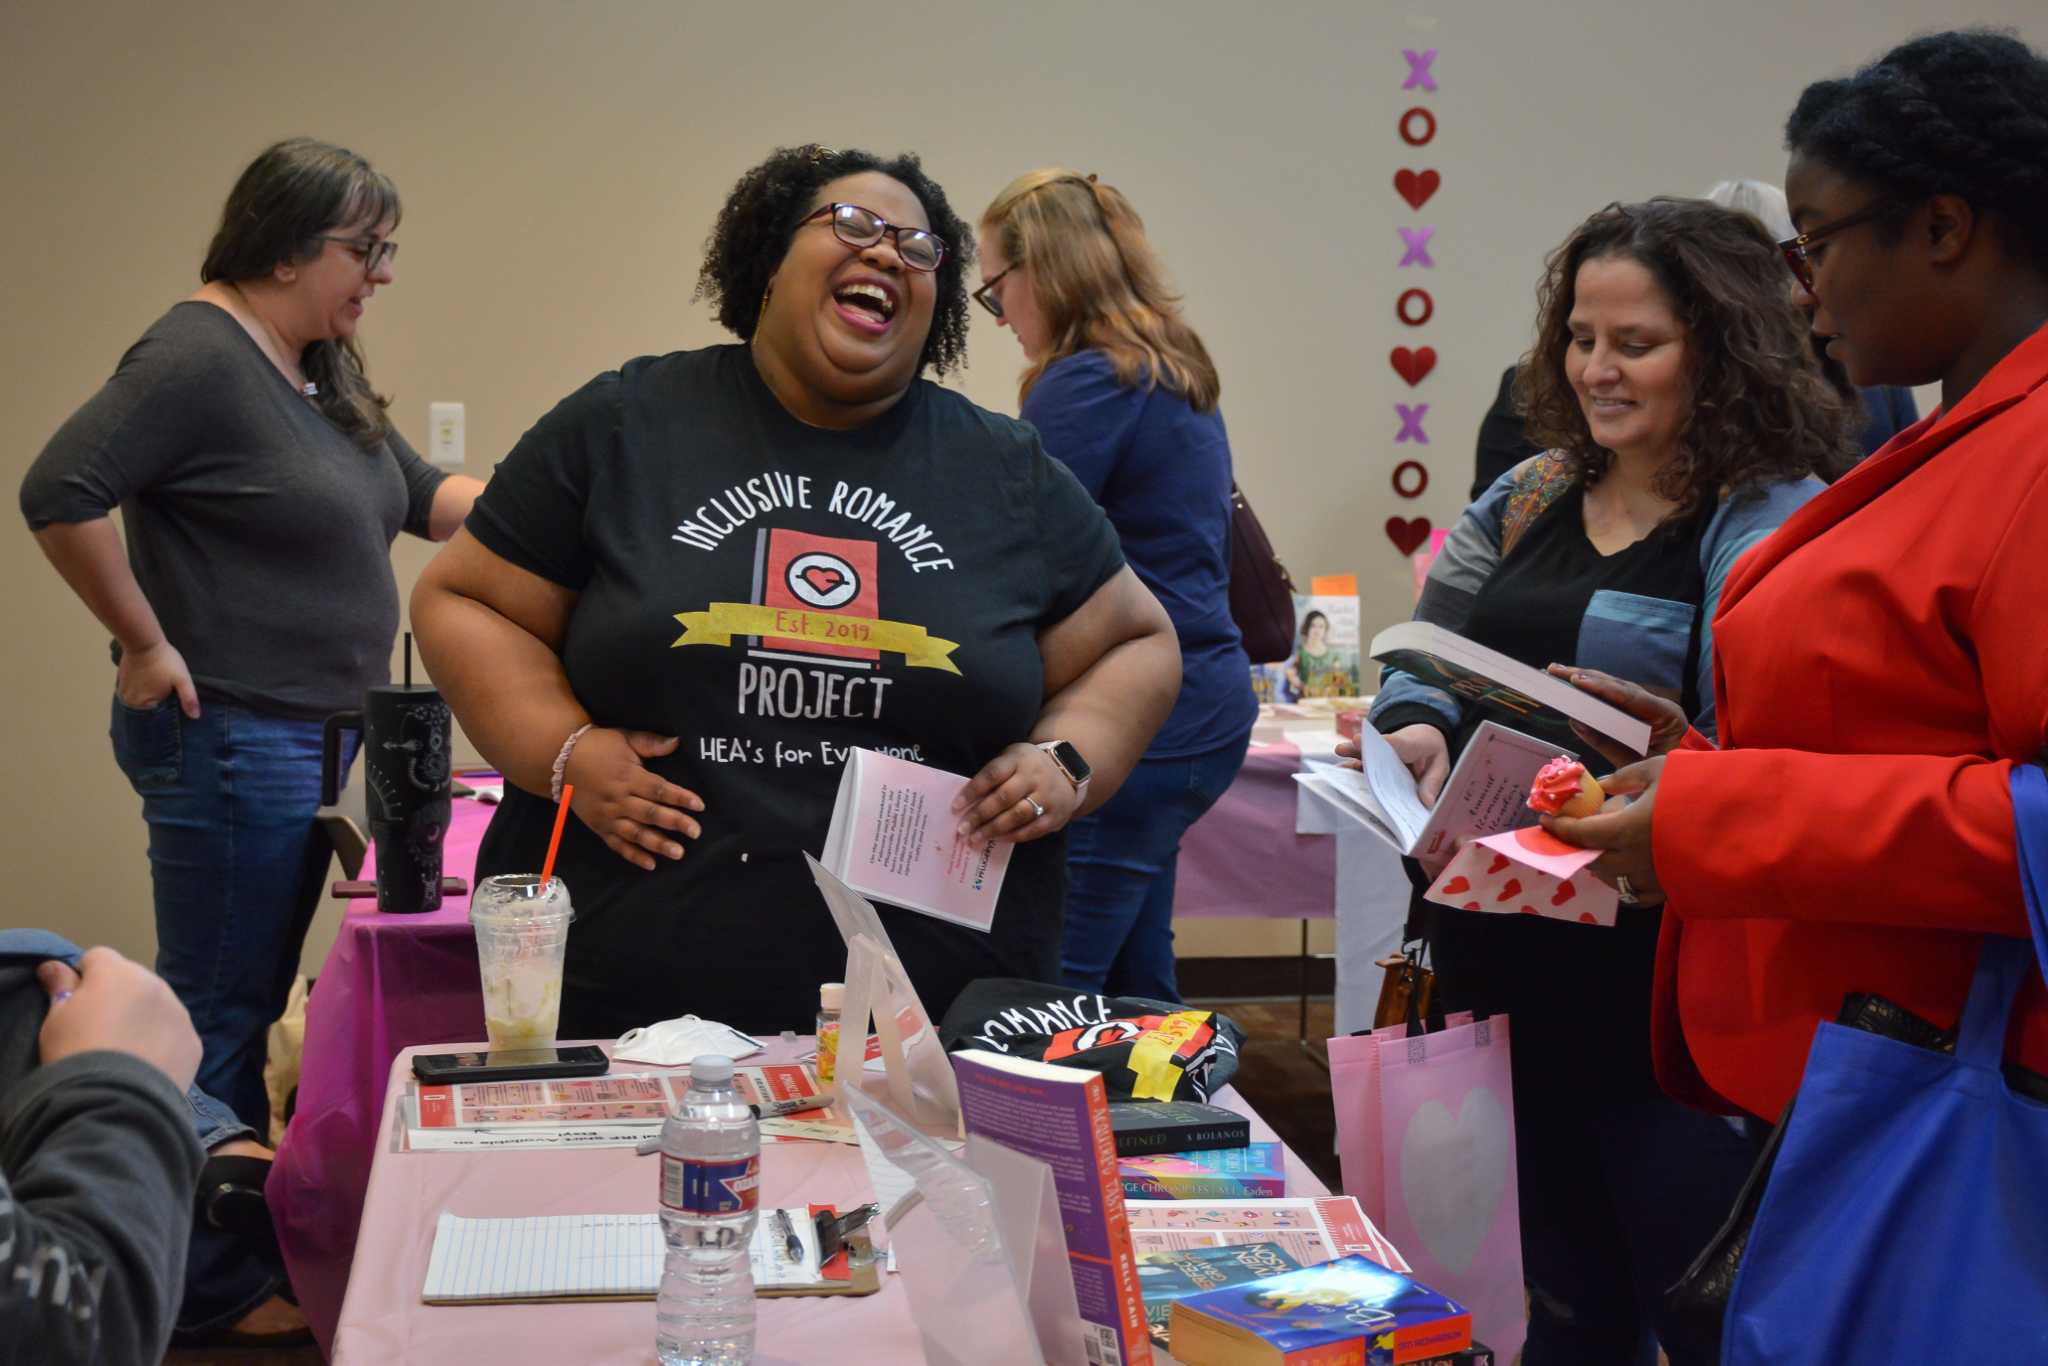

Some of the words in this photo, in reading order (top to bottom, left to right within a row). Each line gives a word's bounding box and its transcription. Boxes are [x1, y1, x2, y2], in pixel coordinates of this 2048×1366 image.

[672, 471, 812, 551] INCLUSIVE
[828, 480, 954, 573] ROMANCE
[775, 611, 814, 635] Est.
[825, 621, 872, 641] 2019
[738, 662, 893, 719] PROJECT
[700, 737, 764, 763] HEA's
[776, 741, 812, 768] for
[820, 741, 924, 765] Evone
[1117, 1133, 1168, 1148] EFINED
[1119, 1254, 1133, 1292] KELLY
[1127, 1294, 1138, 1328] CAIN
